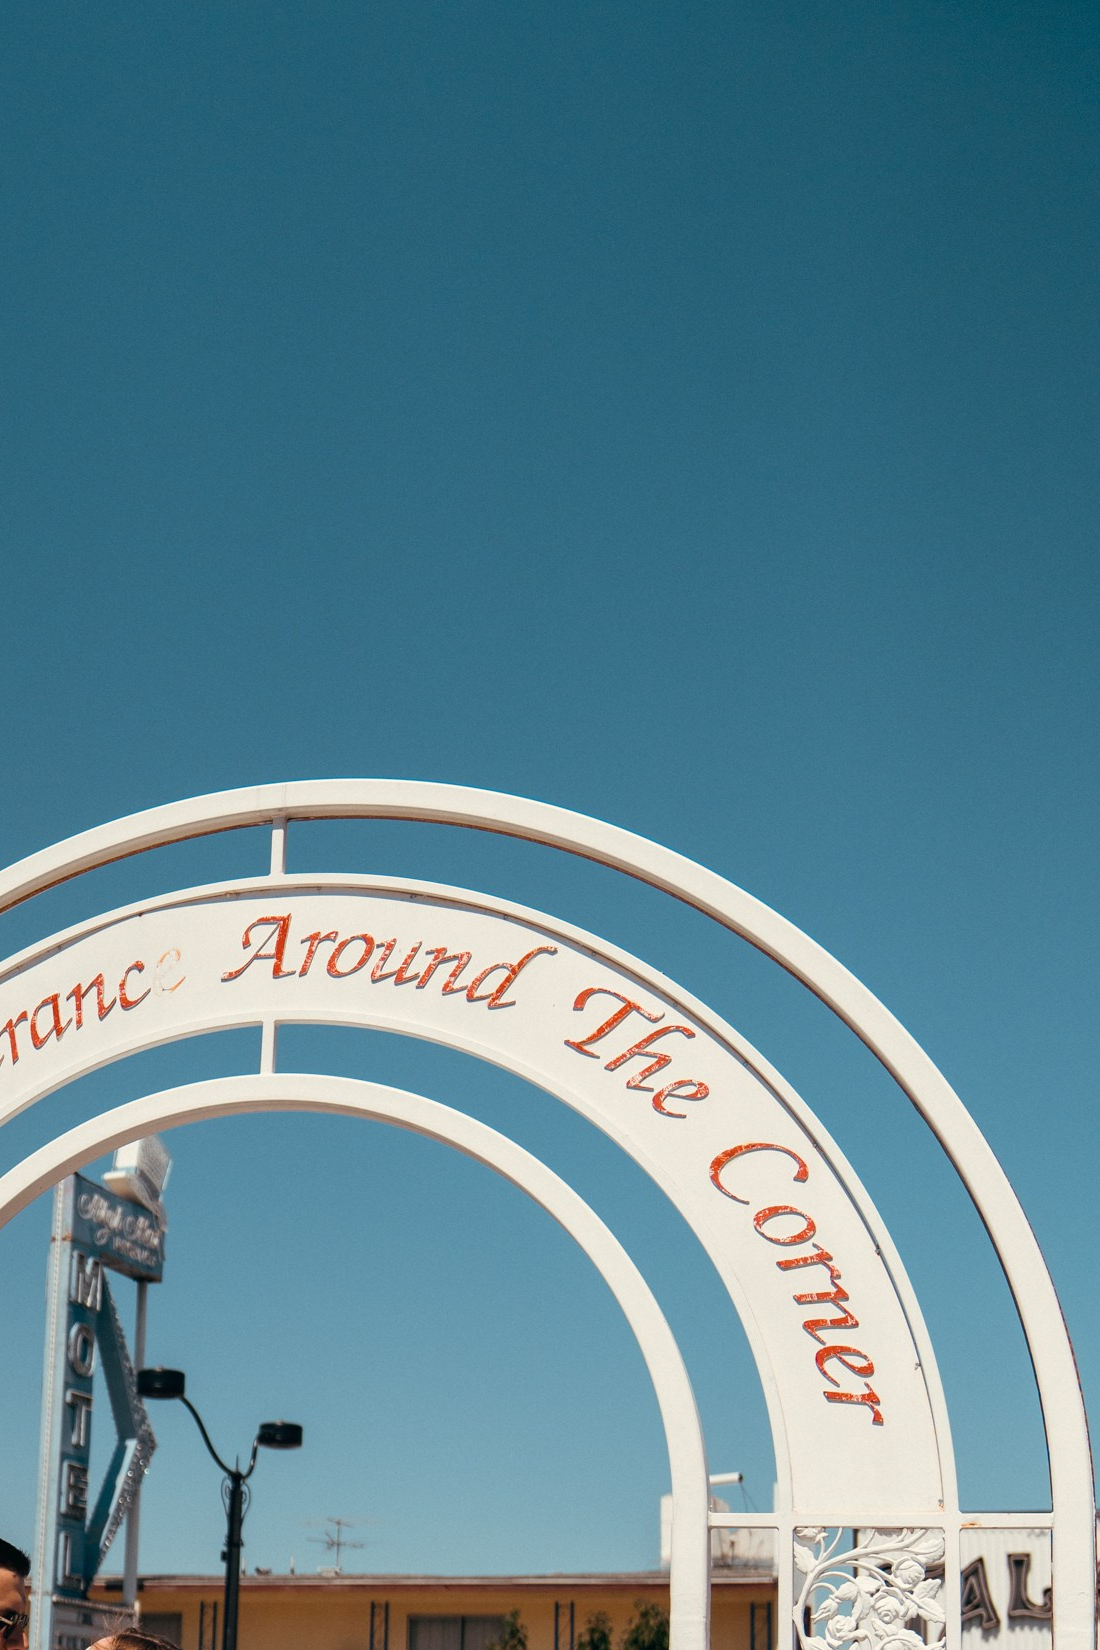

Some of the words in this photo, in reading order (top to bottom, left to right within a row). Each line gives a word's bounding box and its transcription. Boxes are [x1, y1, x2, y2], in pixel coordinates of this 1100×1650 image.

[221, 912, 559, 1011] Around
[563, 986, 710, 1119] The
[709, 1142, 885, 1427] Corner
[56, 1249, 103, 1593] MOTEL
